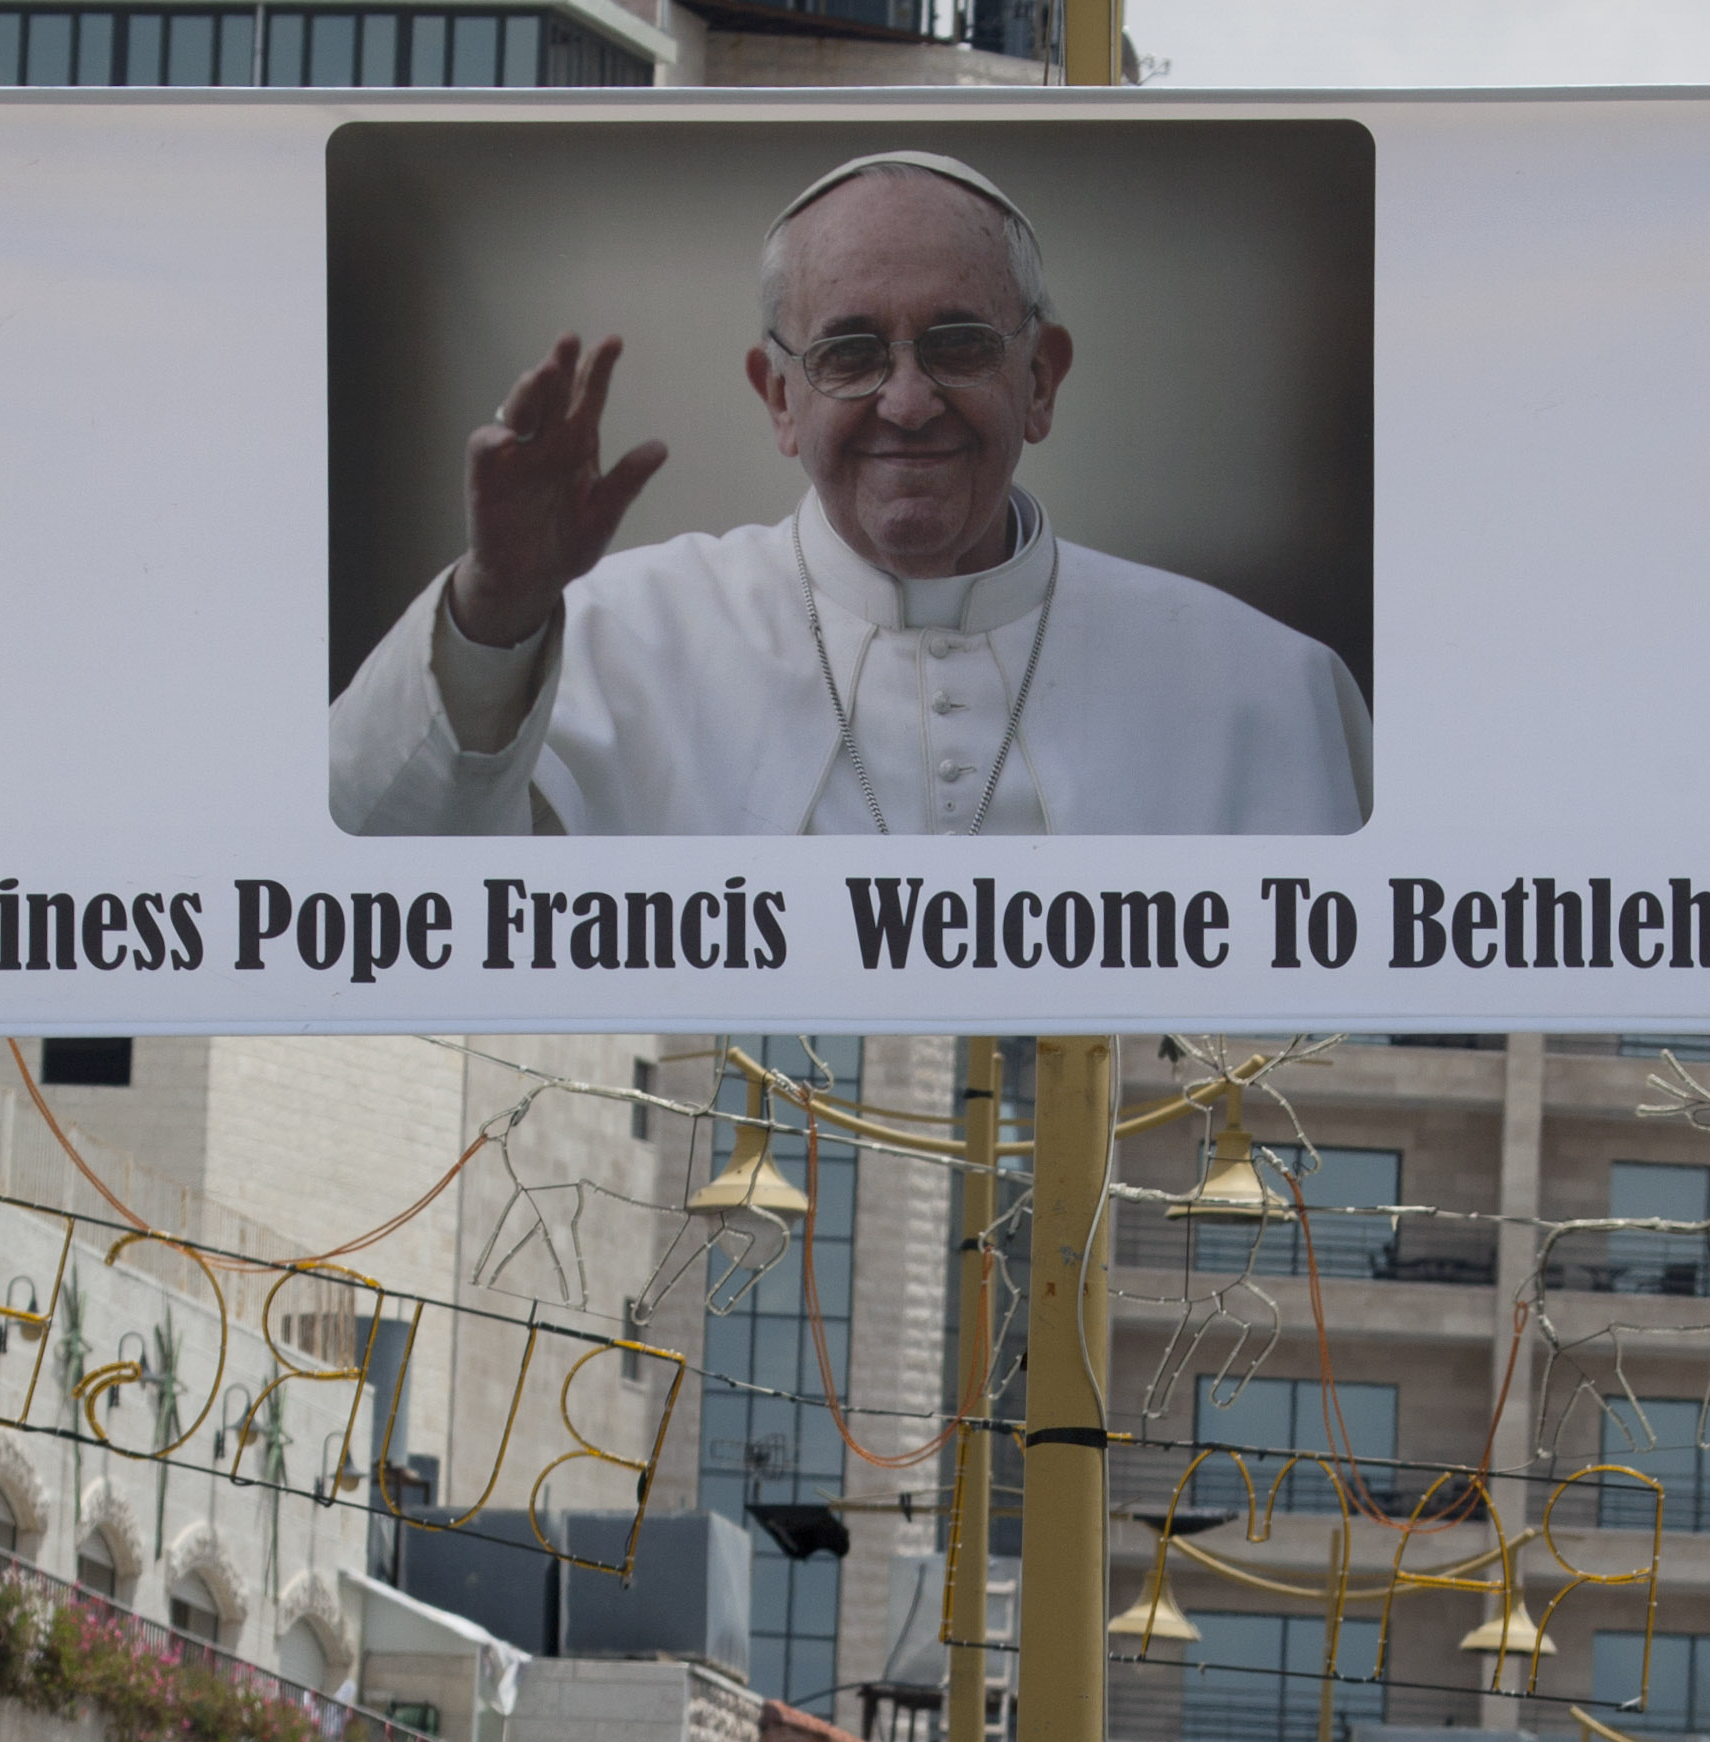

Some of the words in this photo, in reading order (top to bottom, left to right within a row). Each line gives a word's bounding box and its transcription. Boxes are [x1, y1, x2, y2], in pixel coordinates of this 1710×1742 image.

[234, 879, 453, 984] Pope
[482, 876, 789, 971] Francis
[846, 877, 1231, 971] Welcome
[1261, 878, 1358, 970] To
